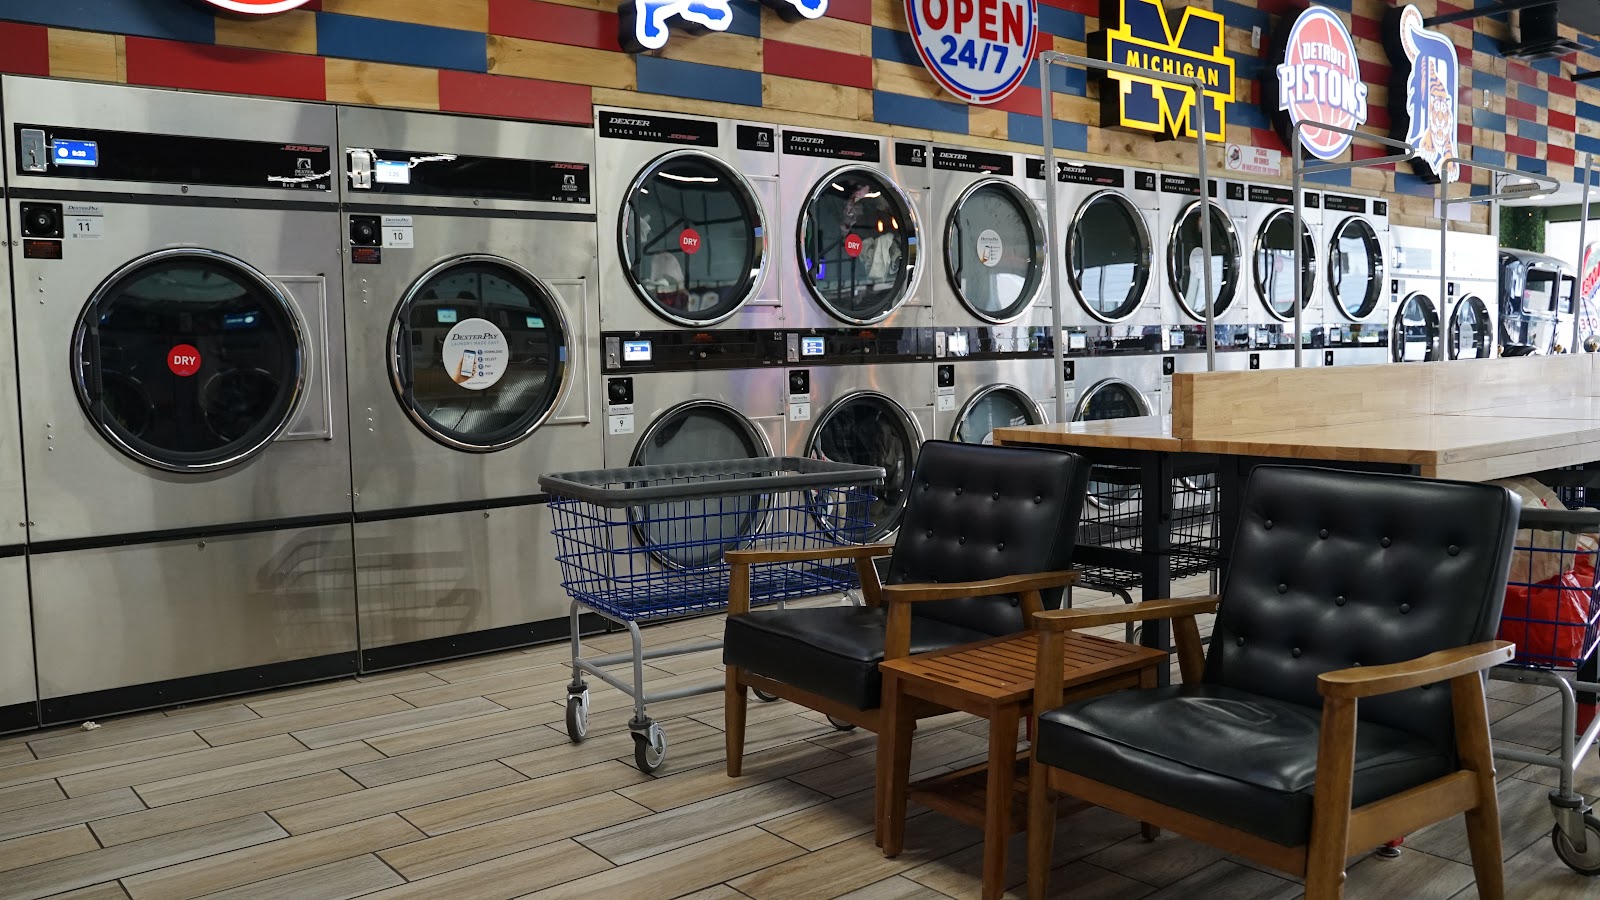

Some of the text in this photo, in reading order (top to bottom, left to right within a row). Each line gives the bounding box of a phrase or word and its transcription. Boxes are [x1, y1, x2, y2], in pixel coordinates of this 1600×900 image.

[922, 0, 1023, 47] OPEN
[941, 35, 1009, 74] 24/7
[1301, 42, 1347, 70] DETROIT
[1126, 49, 1219, 87] MICHIGAN
[1278, 64, 1368, 123] PISTONS
[609, 117, 650, 127] DEXTER
[608, 127, 662, 138] STACK DRYER
[790, 135, 825, 145] DEXTER
[939, 152, 968, 160] DEXTER
[1063, 166, 1087, 174] DEXTER
[78, 222, 90, 231] 11
[393, 232, 403, 240] 10
[683, 237, 698, 246] DRY
[847, 241, 860, 250] DRY
[173, 355, 197, 366] DRY
[619, 419, 625, 427] 9
